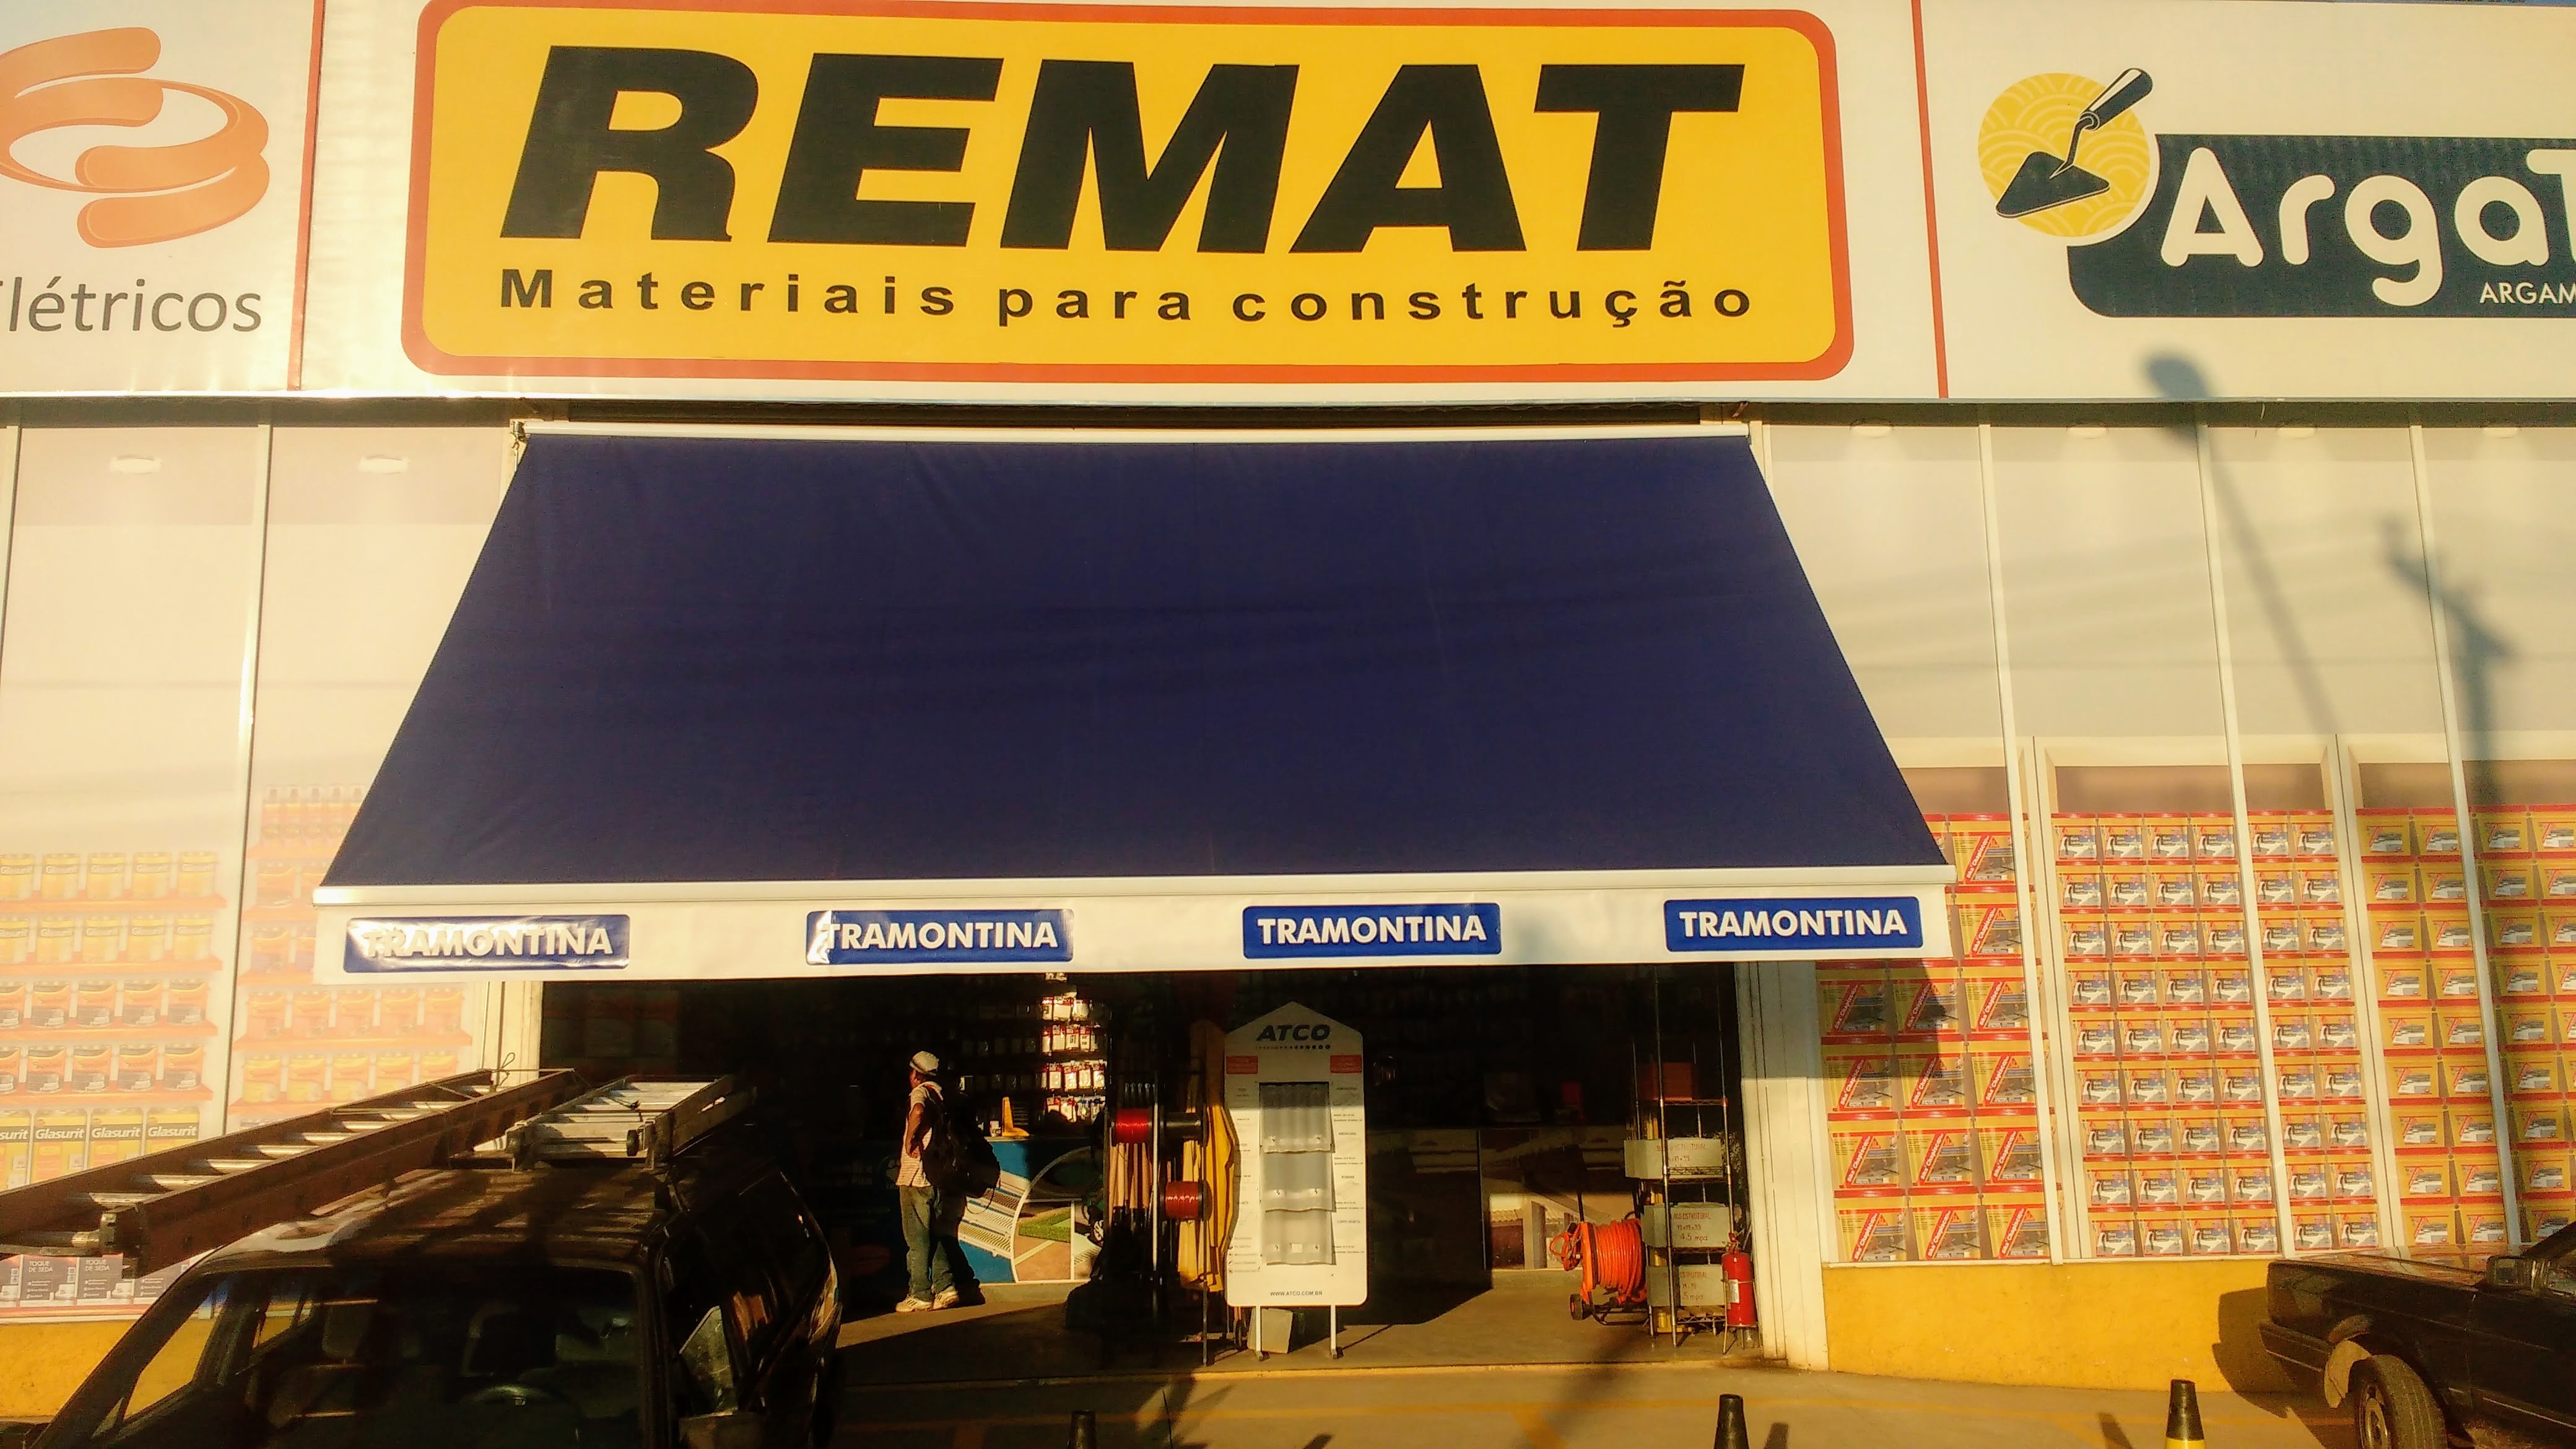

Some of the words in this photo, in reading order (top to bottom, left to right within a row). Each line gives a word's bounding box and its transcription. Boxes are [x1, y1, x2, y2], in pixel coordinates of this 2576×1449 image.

[502, 45, 1745, 254] REMAT
[0, 276, 263, 333] létricos
[507, 271, 954, 316] Materiais
[998, 287, 1190, 328] para
[1232, 280, 1751, 328] construção
[825, 920, 1060, 951] TRAMONTINA
[1258, 915, 1489, 946] TRAMONTINA
[1679, 909, 1908, 938] TRAMONTINA
[362, 927, 613, 958] TRAMONTINA
[1256, 1024, 1331, 1042] ATCO
[35, 1128, 85, 1140] Glasurit
[92, 1126, 141, 1139] Glasurit
[147, 1125, 198, 1138] Glasurit
